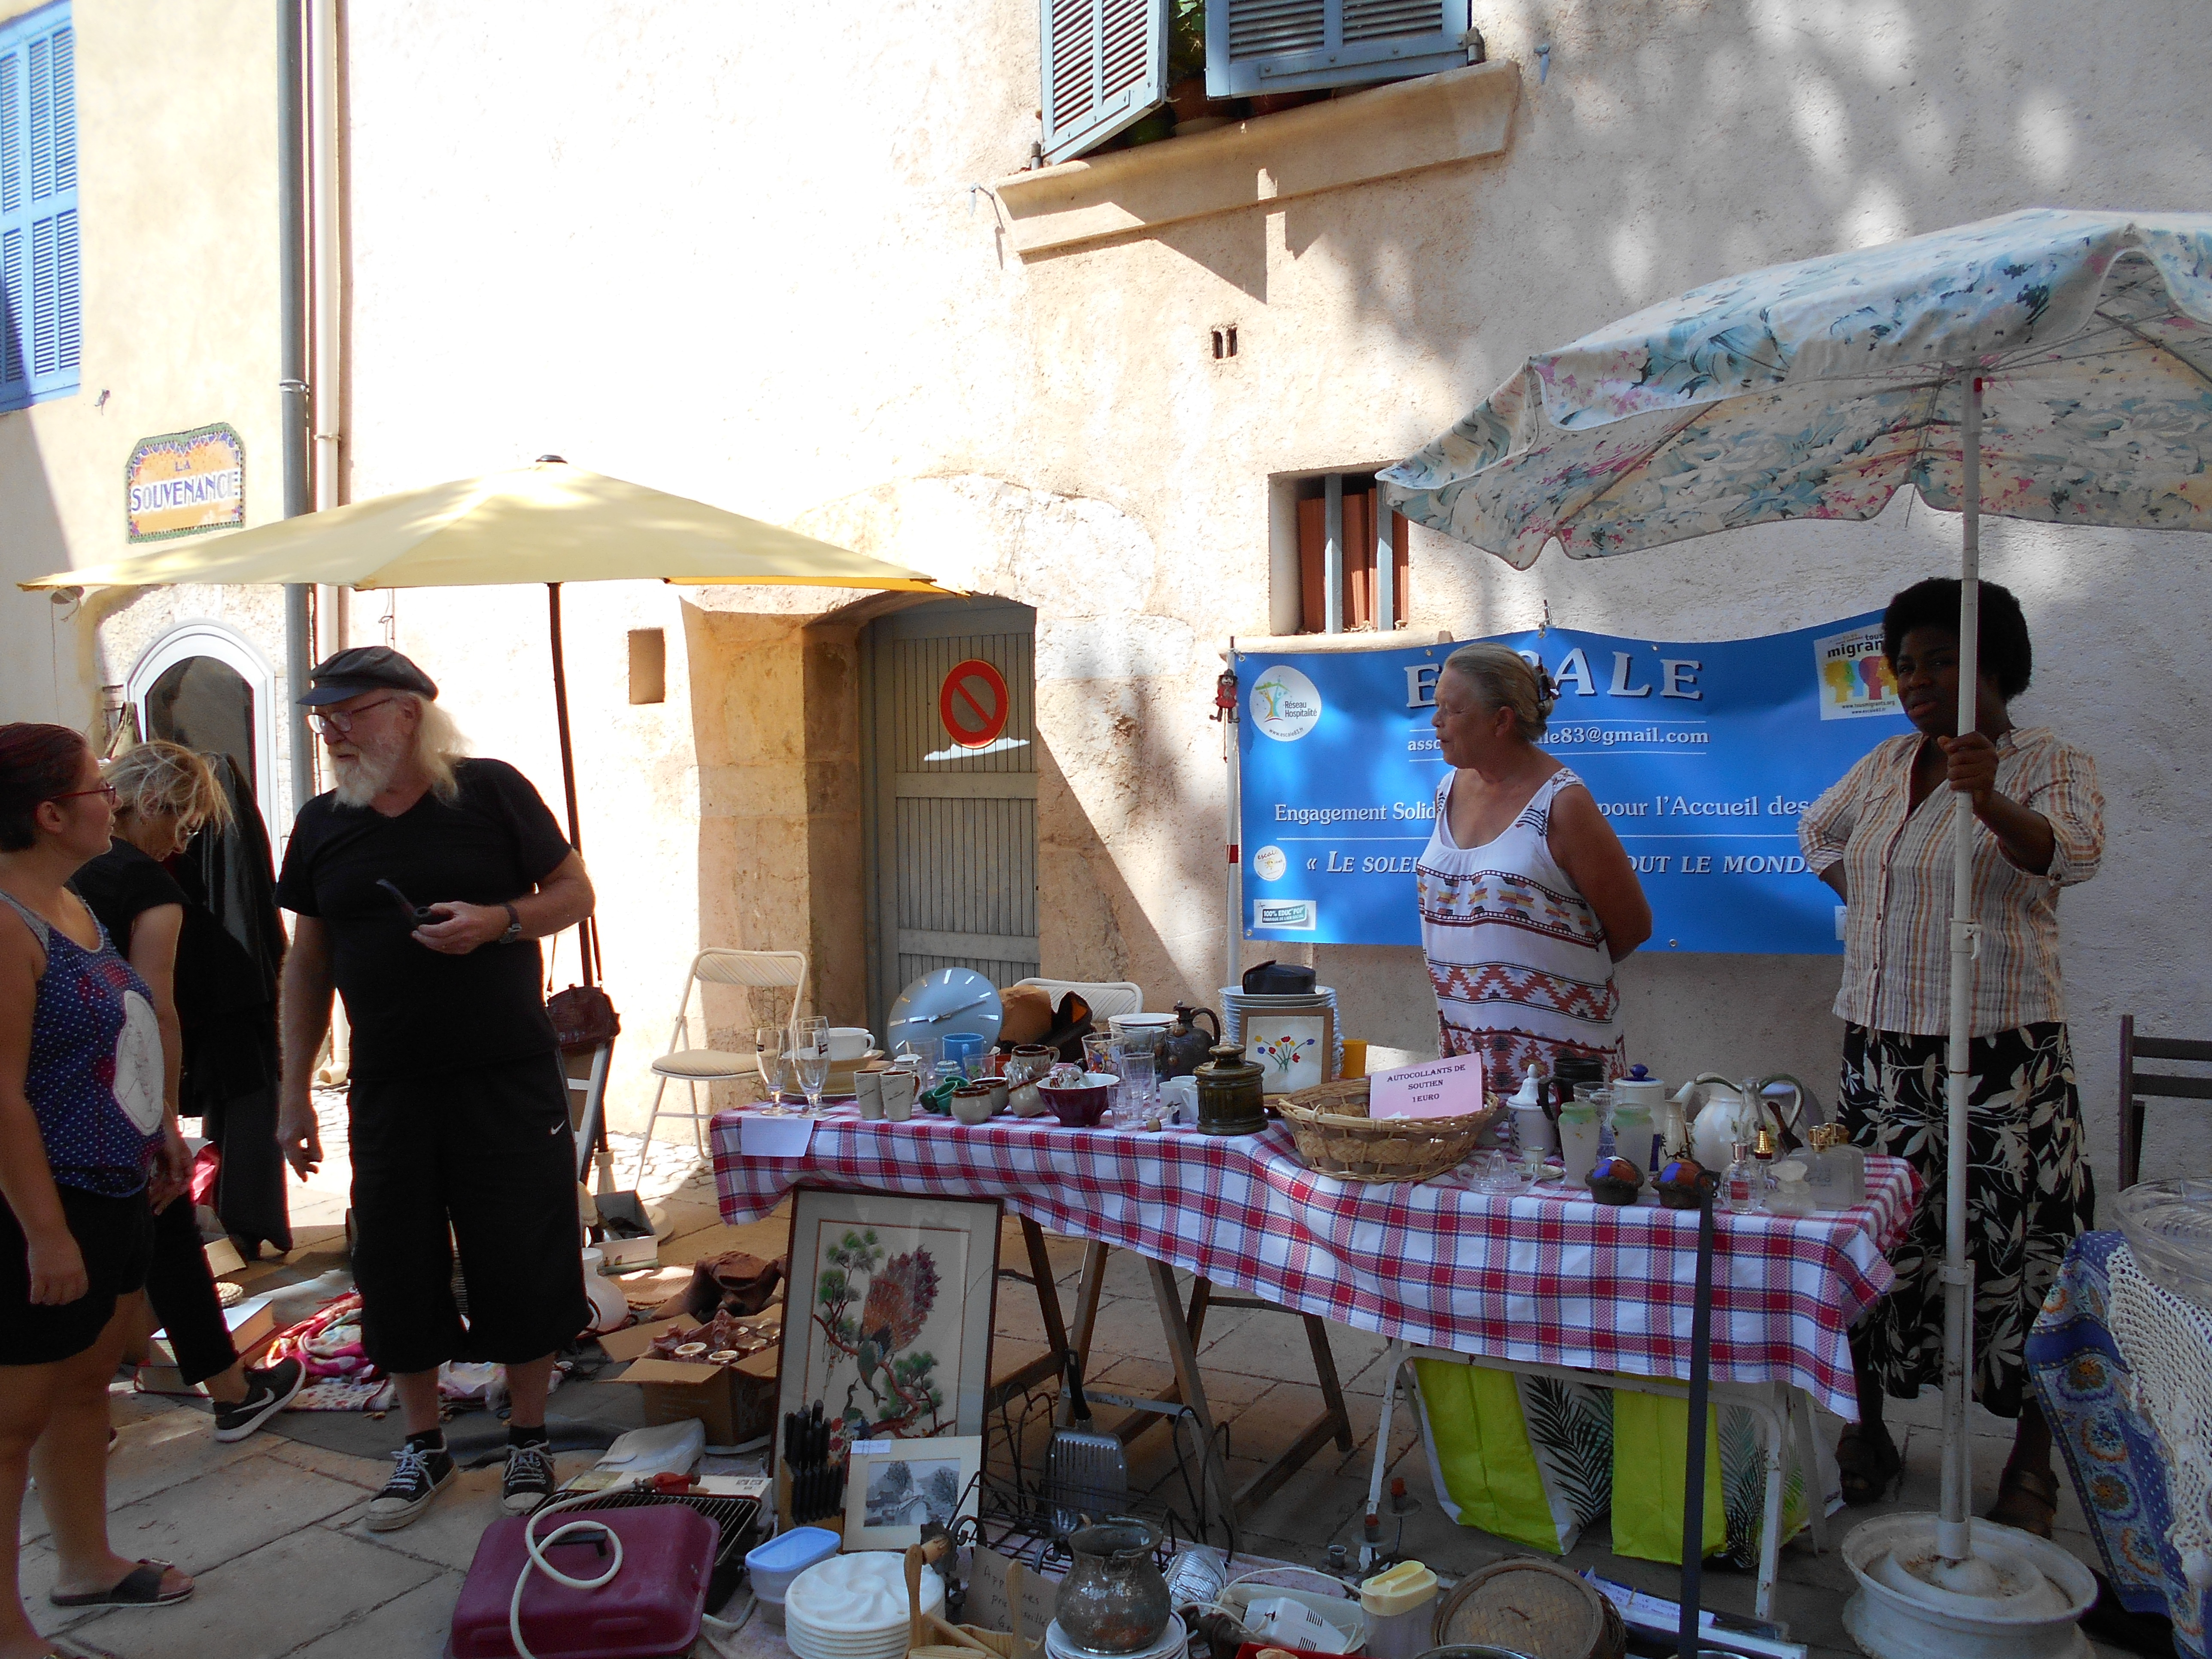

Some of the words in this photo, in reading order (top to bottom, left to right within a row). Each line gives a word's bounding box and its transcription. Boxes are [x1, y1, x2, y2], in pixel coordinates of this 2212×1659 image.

[175, 460, 191, 471] LA
[131, 472, 238, 511] SOUVENANCE
[1828, 640, 1883, 658] migran
[1404, 648, 1702, 708] EALE
[1285, 709, 1317, 719] Hospitalité
[1269, 727, 1304, 737] www.escale83.fr
[1275, 804, 1387, 825] Engagement
[1393, 801, 1435, 820] Solid
[1597, 803, 1648, 816] pour
[1656, 796, 1759, 816] l'Accueil
[1768, 796, 1809, 815] des
[1326, 851, 1356, 873] LE
[1362, 857, 1418, 873] SOLEI
[1627, 856, 1671, 873] OUT
[1680, 856, 1711, 874] LE
[1723, 856, 1814, 874] MOND
[1387, 1066, 1452, 1082] AUTOCOLLANTS
[1454, 1064, 1466, 1072] DE
[1408, 1079, 1443, 1090] SOUTIEN
